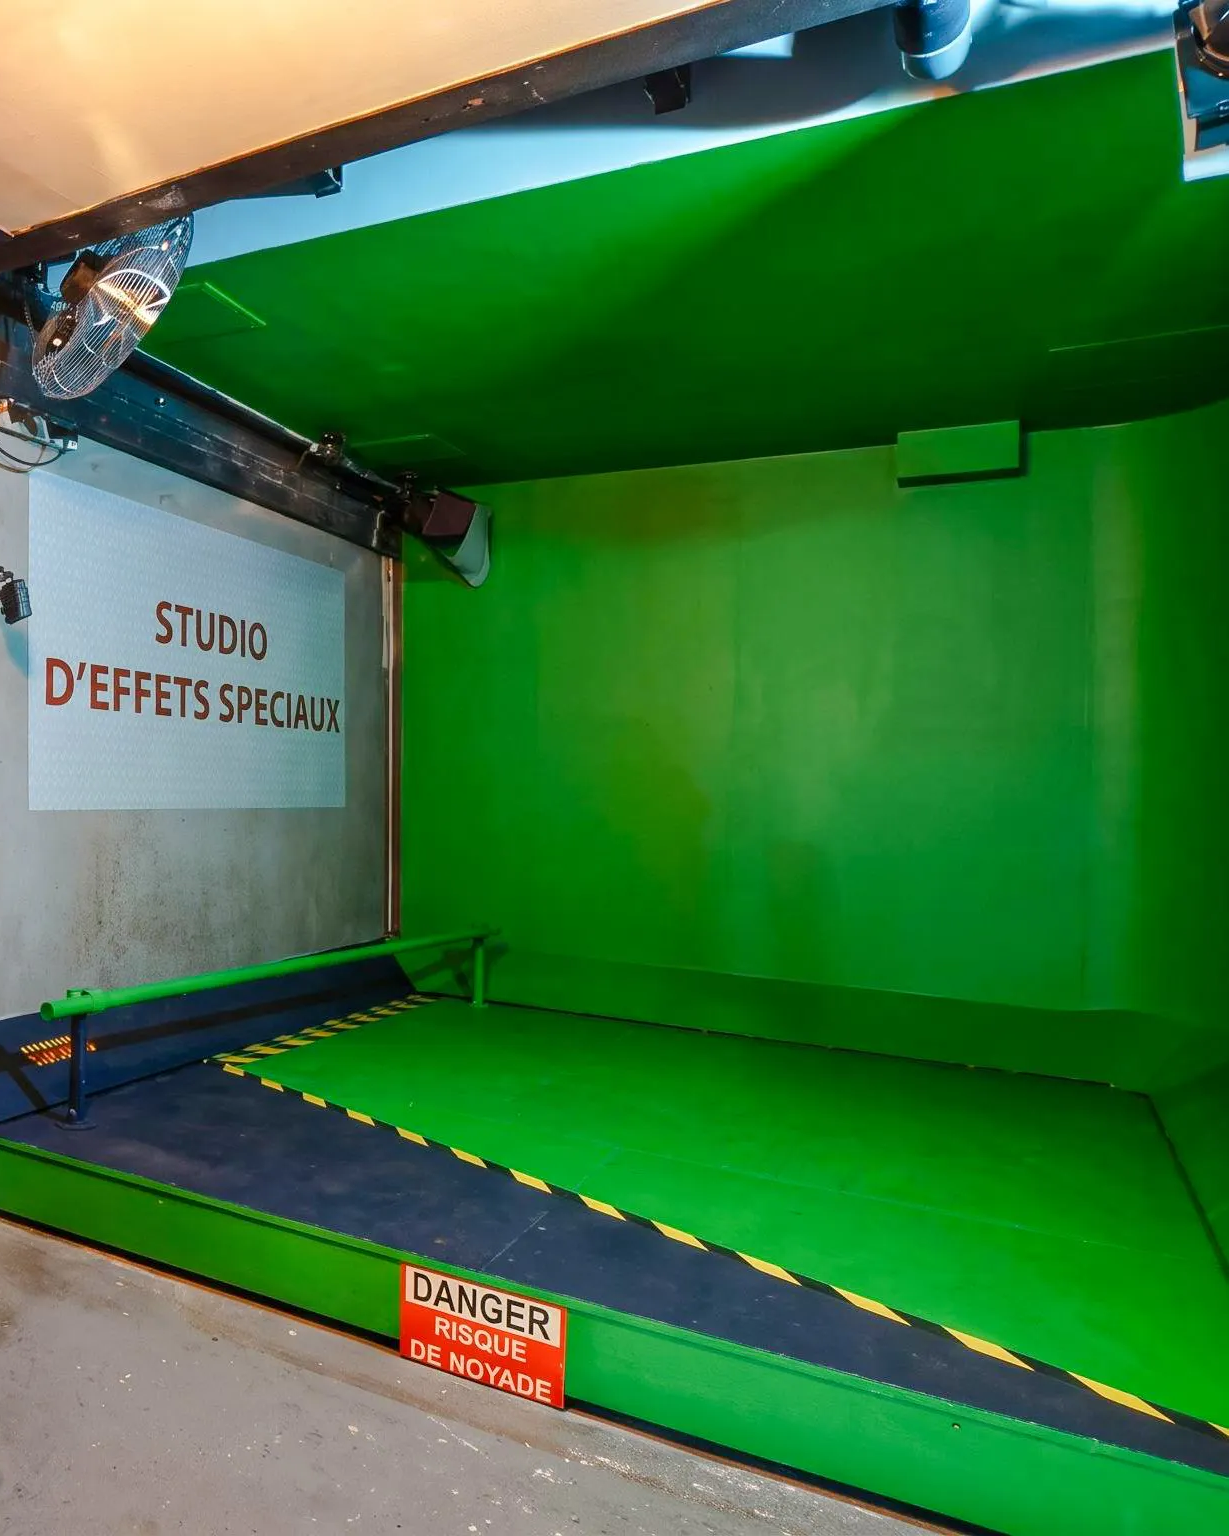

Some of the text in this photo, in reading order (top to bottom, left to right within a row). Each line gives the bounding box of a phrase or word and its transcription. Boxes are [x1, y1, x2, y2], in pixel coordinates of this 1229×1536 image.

[155, 600, 268, 661] STUDIO
[45, 657, 341, 733] D'EFFETS SPECIAUX
[413, 1271, 551, 1341] DANGER
[410, 1338, 552, 1403] DE NOYADE
[434, 1316, 527, 1363] RISQUE
